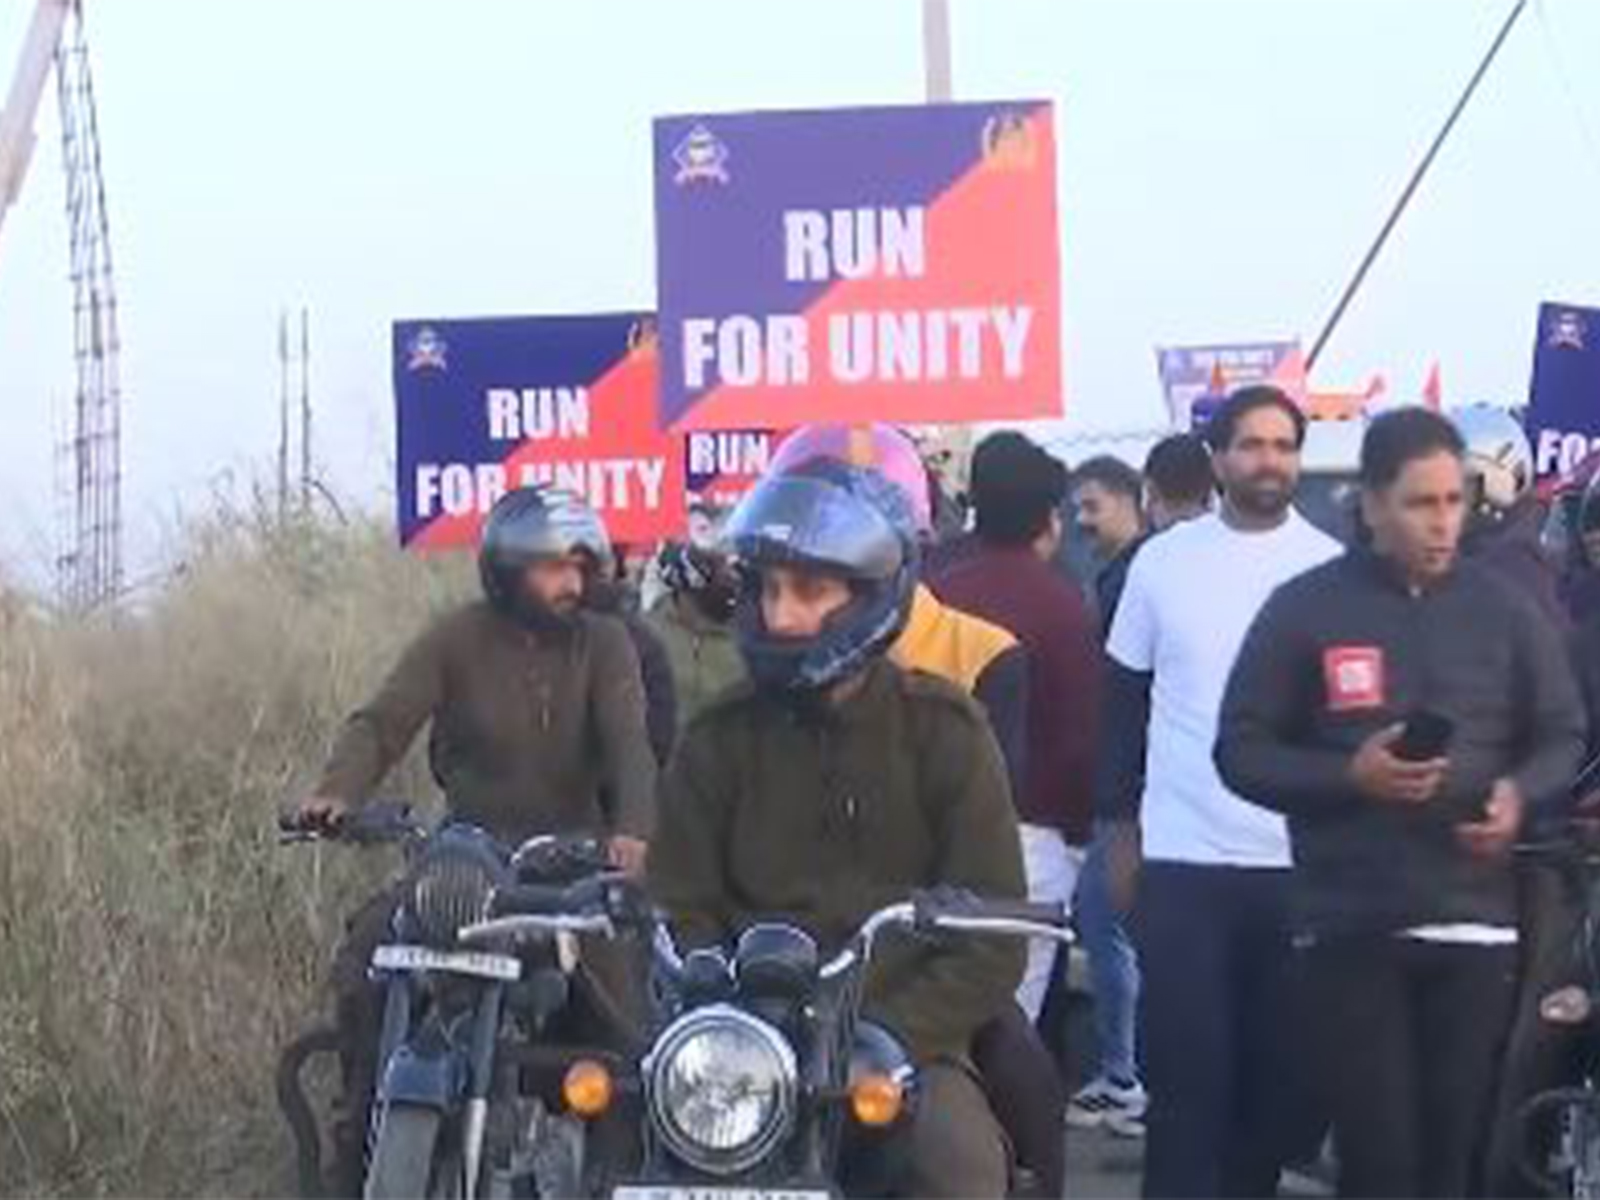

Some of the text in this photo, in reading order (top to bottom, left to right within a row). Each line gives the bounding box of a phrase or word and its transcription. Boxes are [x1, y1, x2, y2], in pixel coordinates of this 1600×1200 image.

[784, 206, 926, 282] RUN
[683, 306, 1032, 388] FOR UNITY
[488, 386, 590, 440] RUN
[689, 431, 769, 475] RUN
[416, 461, 507, 518] FOR
